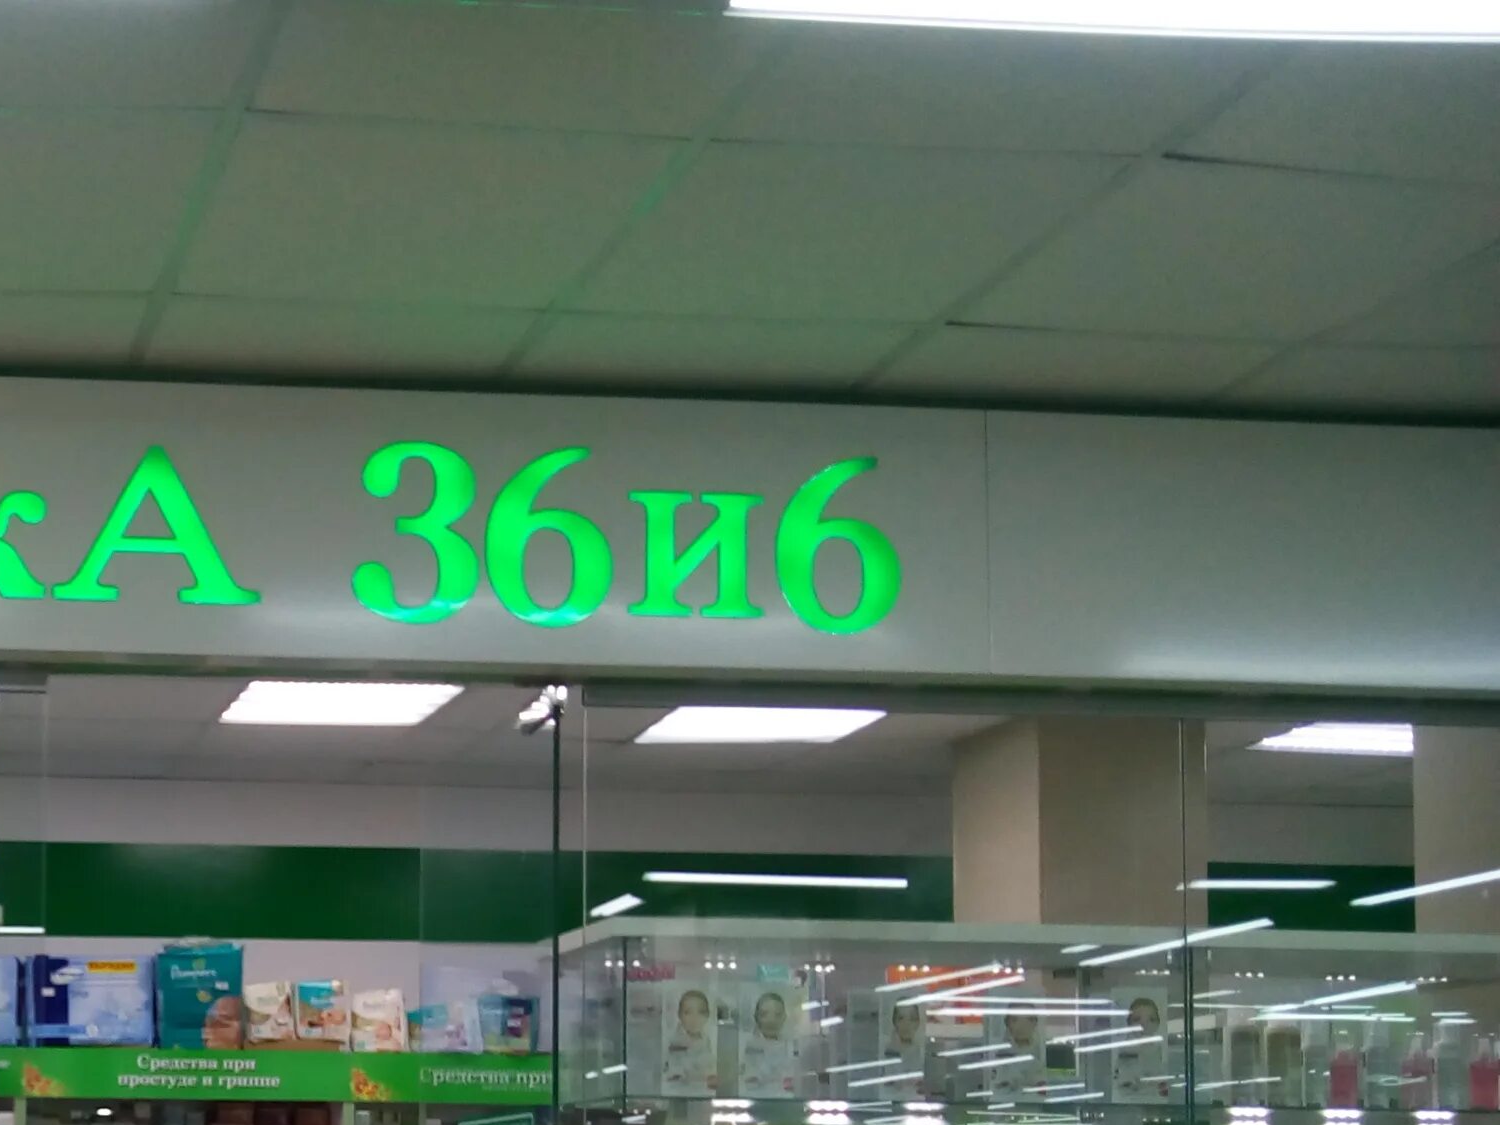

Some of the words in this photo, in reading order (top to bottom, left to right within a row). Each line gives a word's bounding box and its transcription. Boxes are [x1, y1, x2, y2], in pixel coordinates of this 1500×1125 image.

[351, 441, 902, 635] 36и6
[136, 1054, 218, 1073] Средства
[223, 1058, 256, 1073] при
[117, 1074, 197, 1088] простуде
[202, 1076, 213, 1087] и
